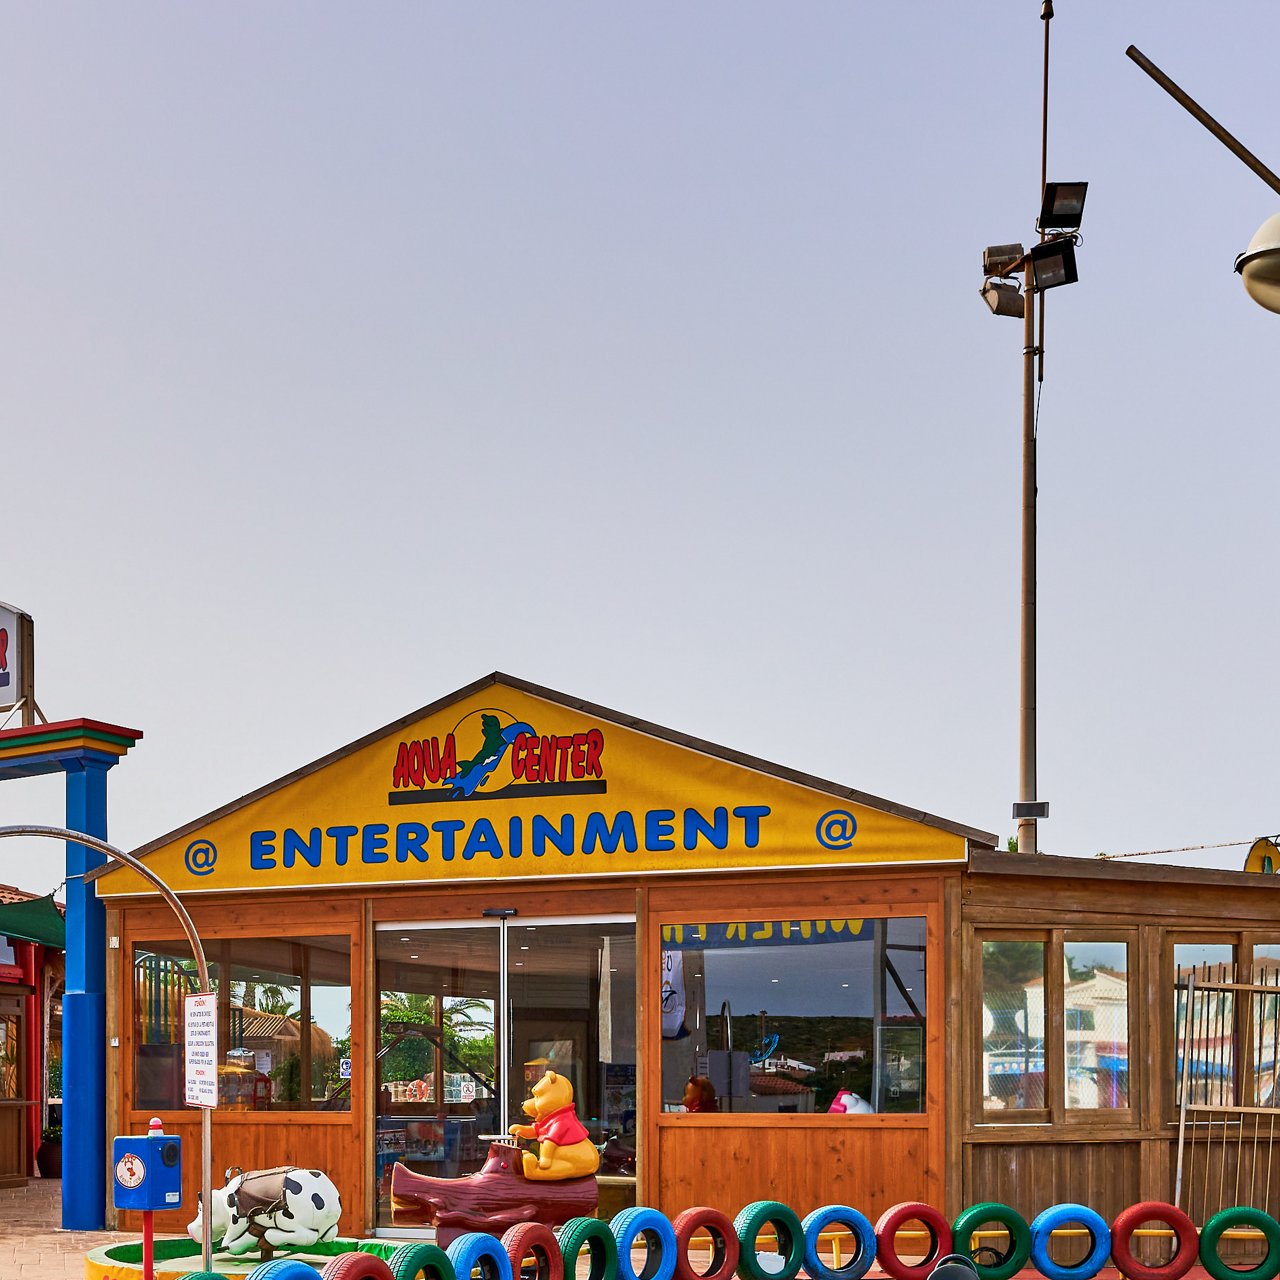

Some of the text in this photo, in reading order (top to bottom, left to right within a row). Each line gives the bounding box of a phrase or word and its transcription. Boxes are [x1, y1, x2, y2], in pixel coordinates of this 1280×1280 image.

[392, 728, 605, 790] AQUA CENTER
[184, 805, 858, 877] @ ENTERTAINMENT @
